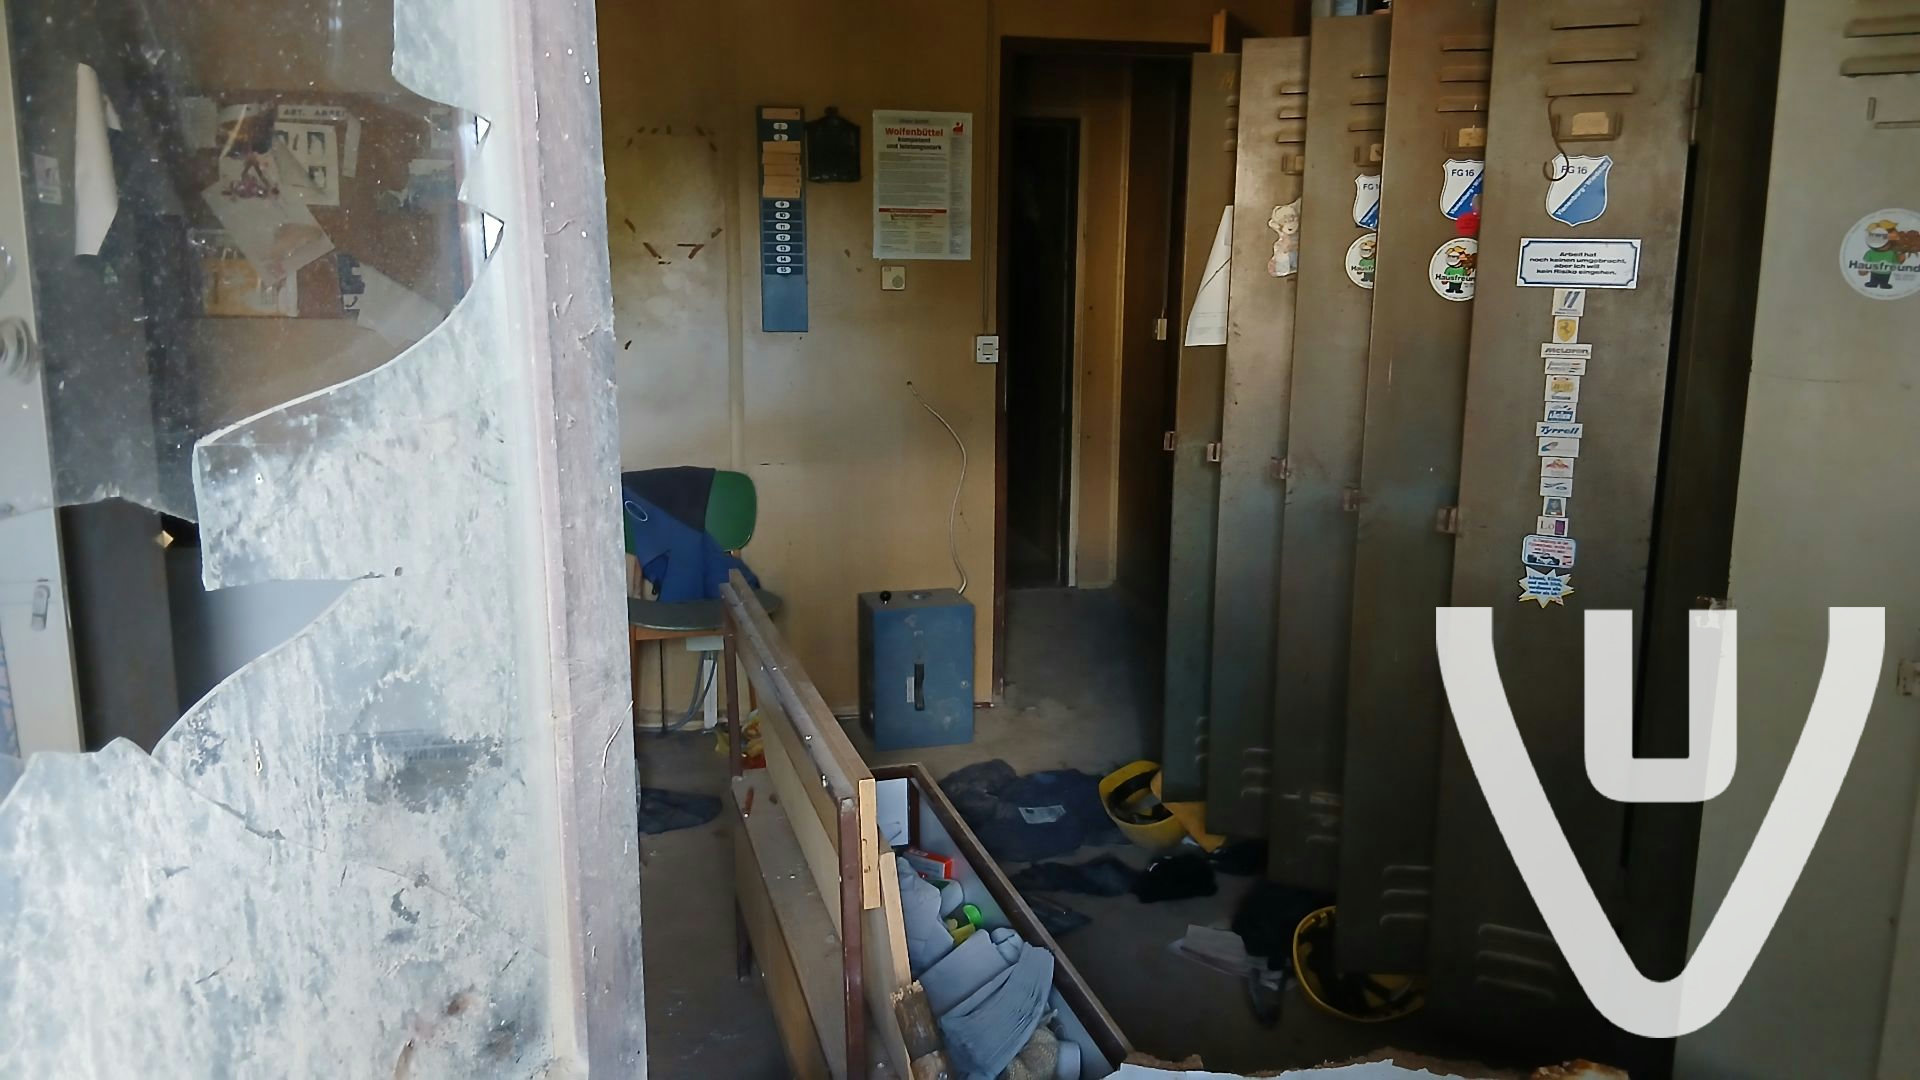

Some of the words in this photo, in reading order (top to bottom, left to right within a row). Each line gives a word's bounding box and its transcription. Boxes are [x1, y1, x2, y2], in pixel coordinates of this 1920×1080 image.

[885, 127, 944, 137] Wolfenbüttel
[1451, 169, 1464, 177] FG
[1465, 169, 1475, 177] 16
[1560, 166, 1575, 174] FG
[1577, 166, 1588, 175] 16
[1362, 183, 1374, 191] FG
[1435, 273, 1476, 281] Hausfreun
[1540, 425, 1580, 435] Tyrrell
